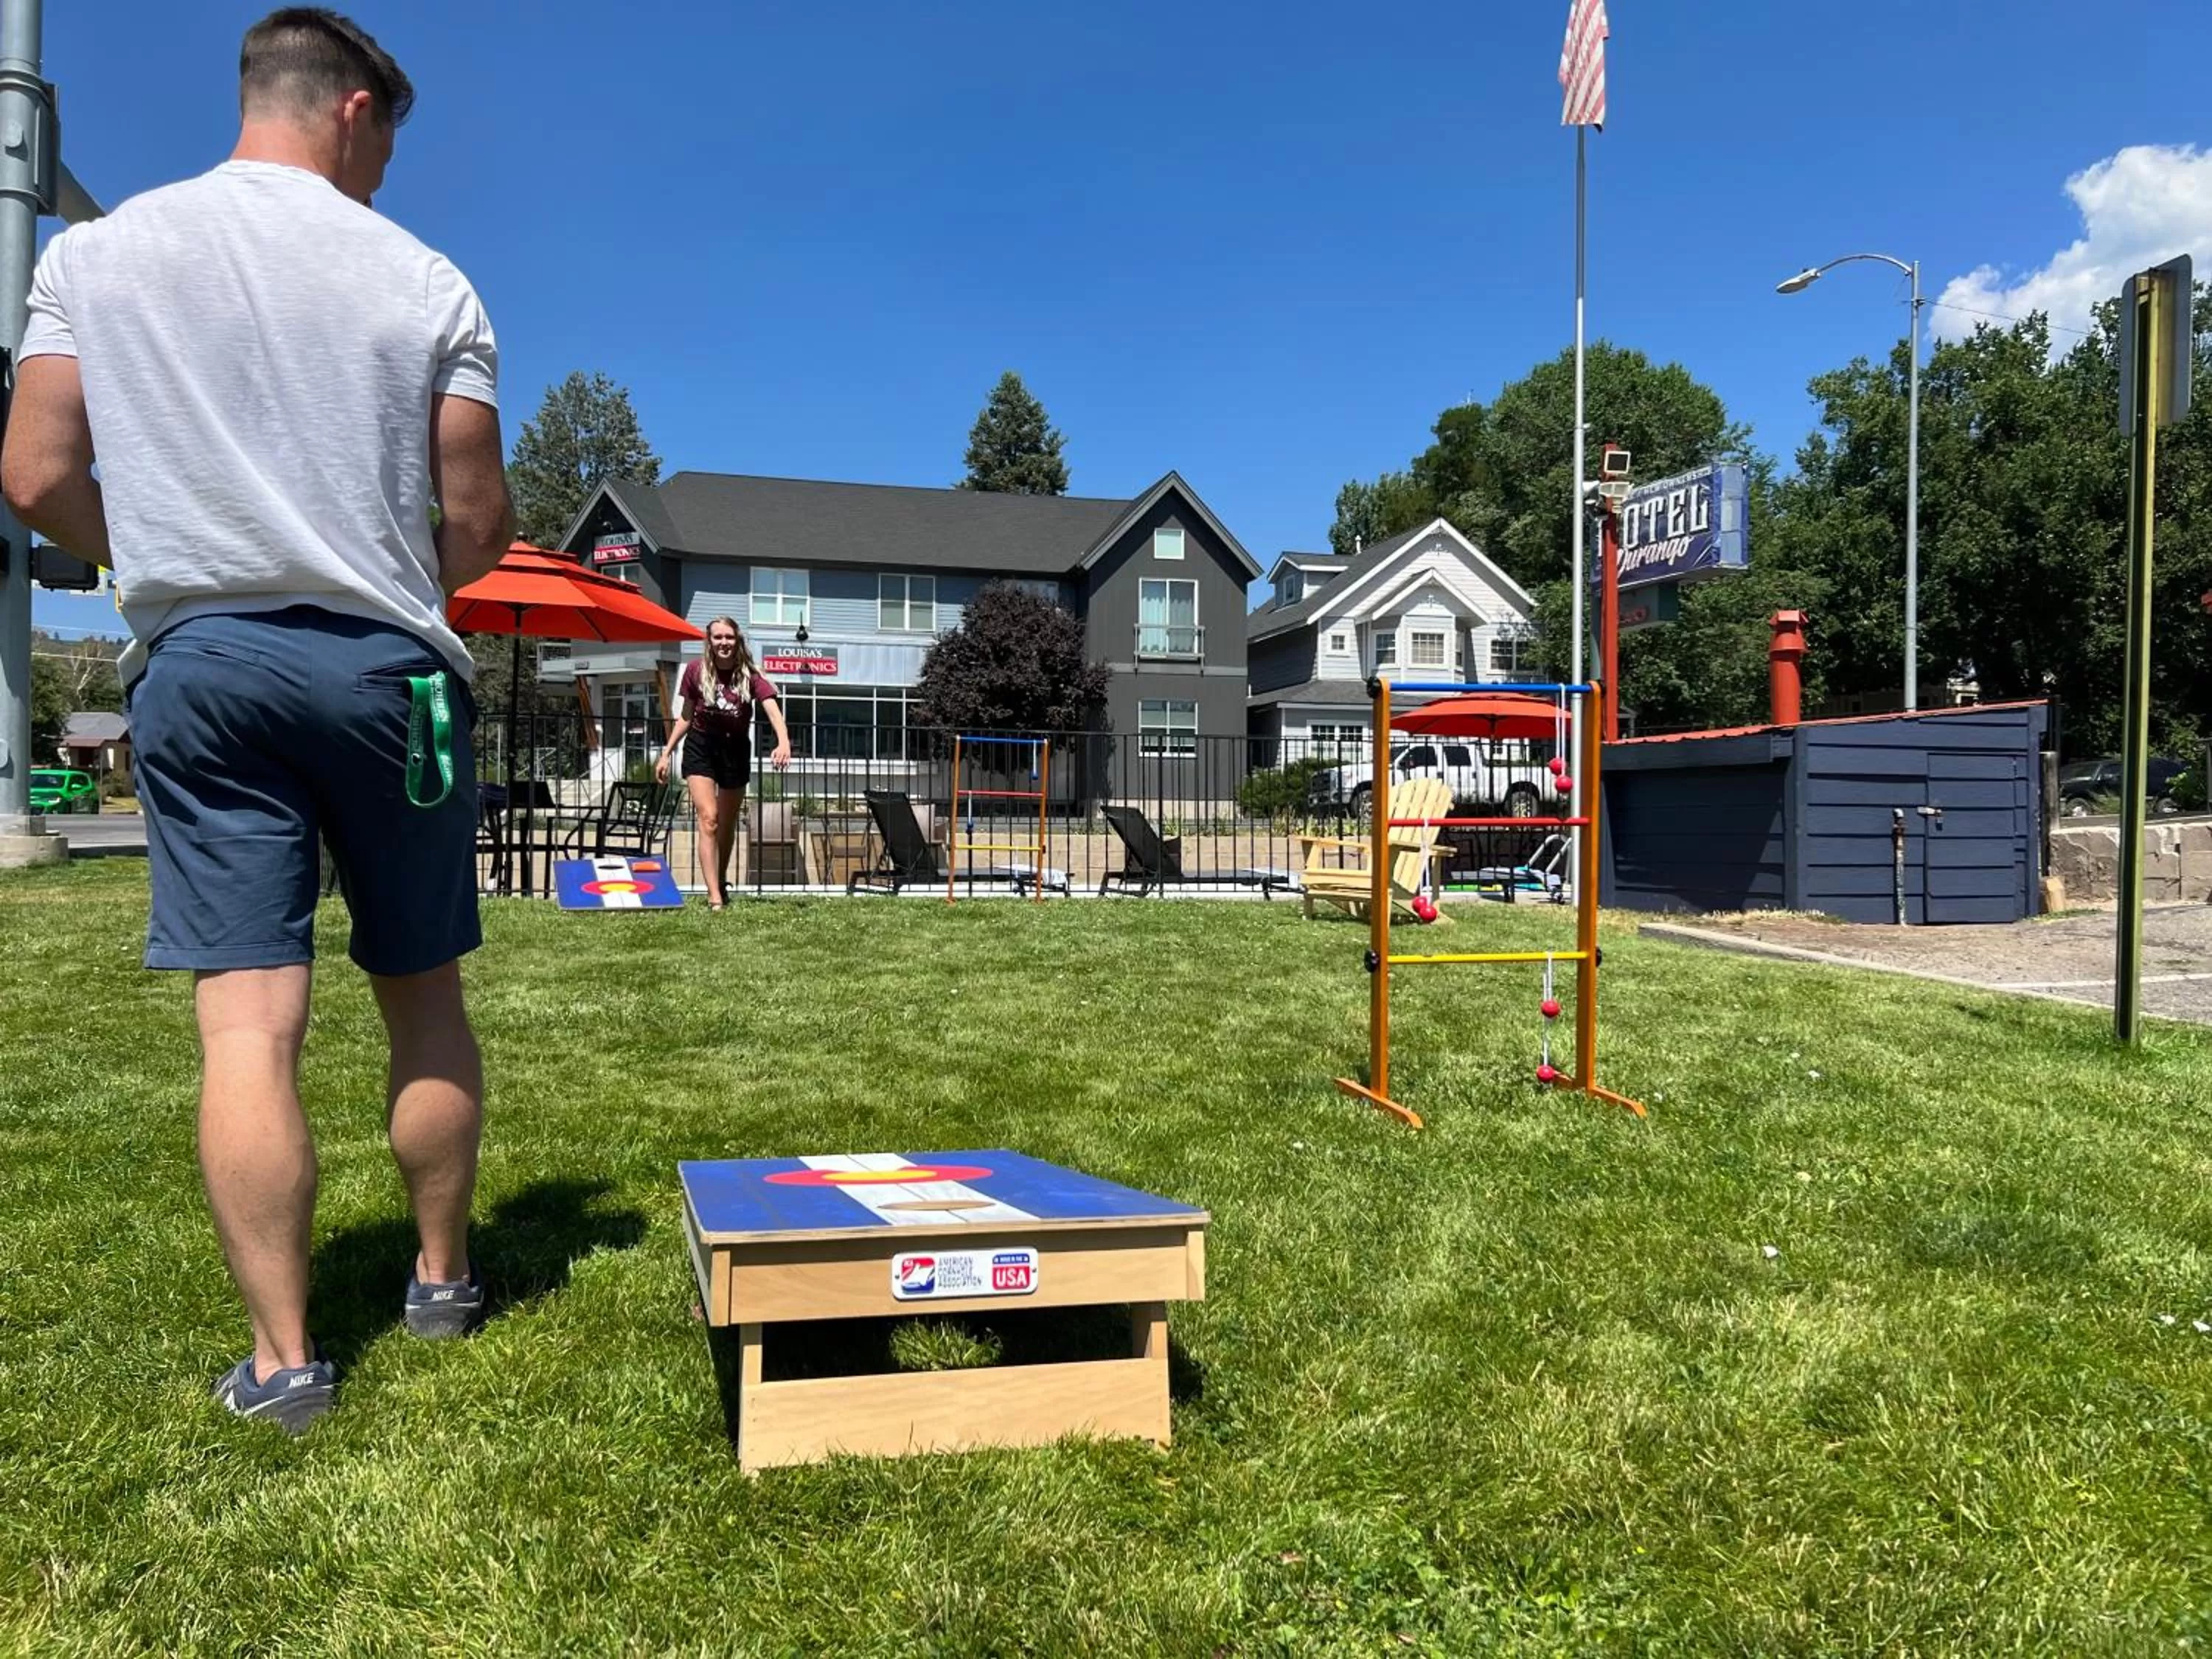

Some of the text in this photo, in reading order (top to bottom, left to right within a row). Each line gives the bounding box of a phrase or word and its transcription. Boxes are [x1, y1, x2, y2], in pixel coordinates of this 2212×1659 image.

[1598, 484, 1709, 557] OTEL
[778, 648, 822, 658] LOUISA'S
[763, 661, 837, 672] ELECTRONICS
[996, 1267, 1027, 1287] USA
[432, 1290, 454, 1301] NIKE
[288, 1372, 315, 1389] NIKE
